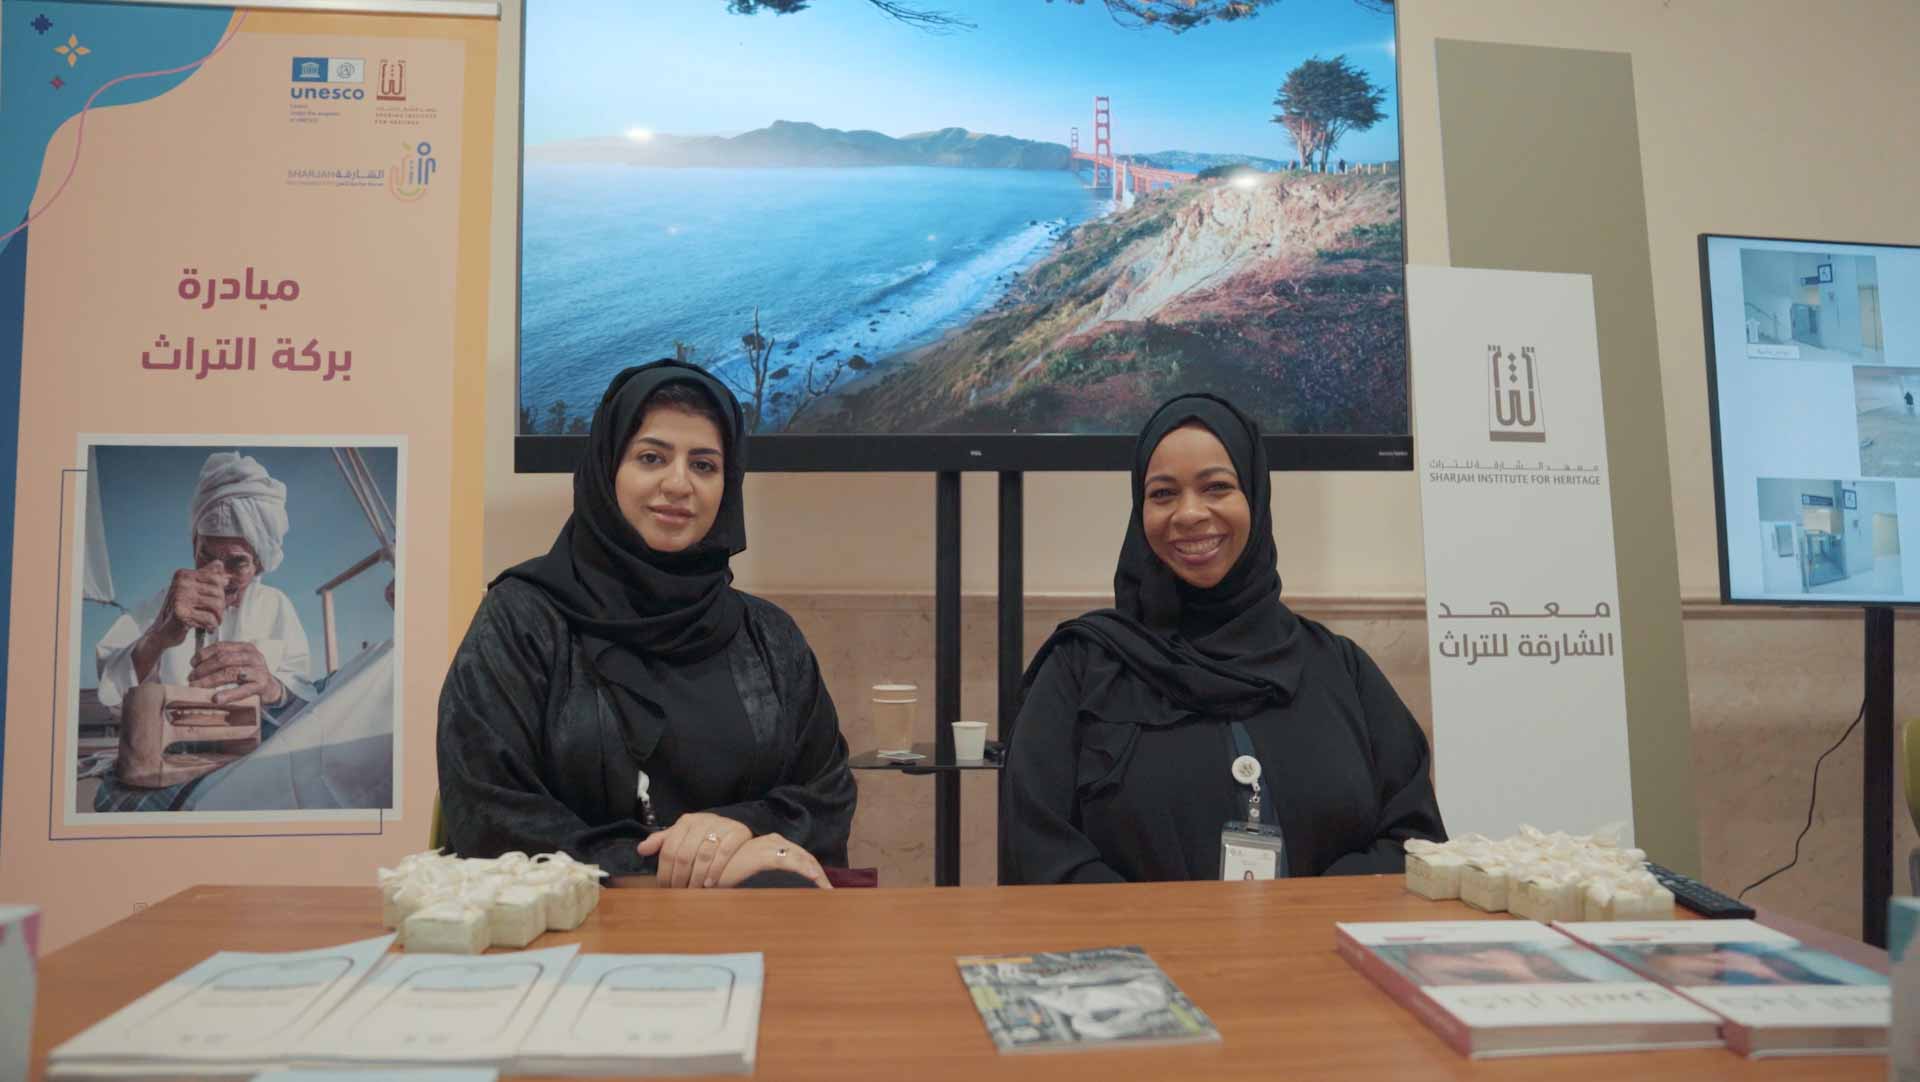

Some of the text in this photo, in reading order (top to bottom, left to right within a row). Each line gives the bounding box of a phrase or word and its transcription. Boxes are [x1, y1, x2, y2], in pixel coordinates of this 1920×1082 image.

[290, 87, 365, 101] unesco
[177, 266, 300, 311] مبادرة
[141, 333, 352, 382] بركة التراث
[1429, 472, 1601, 486] SHARJAH INSTITUTE FOR HERITAGE
[1437, 600, 1611, 619] معهد
[1438, 629, 1615, 666] الشارقة للتراث
